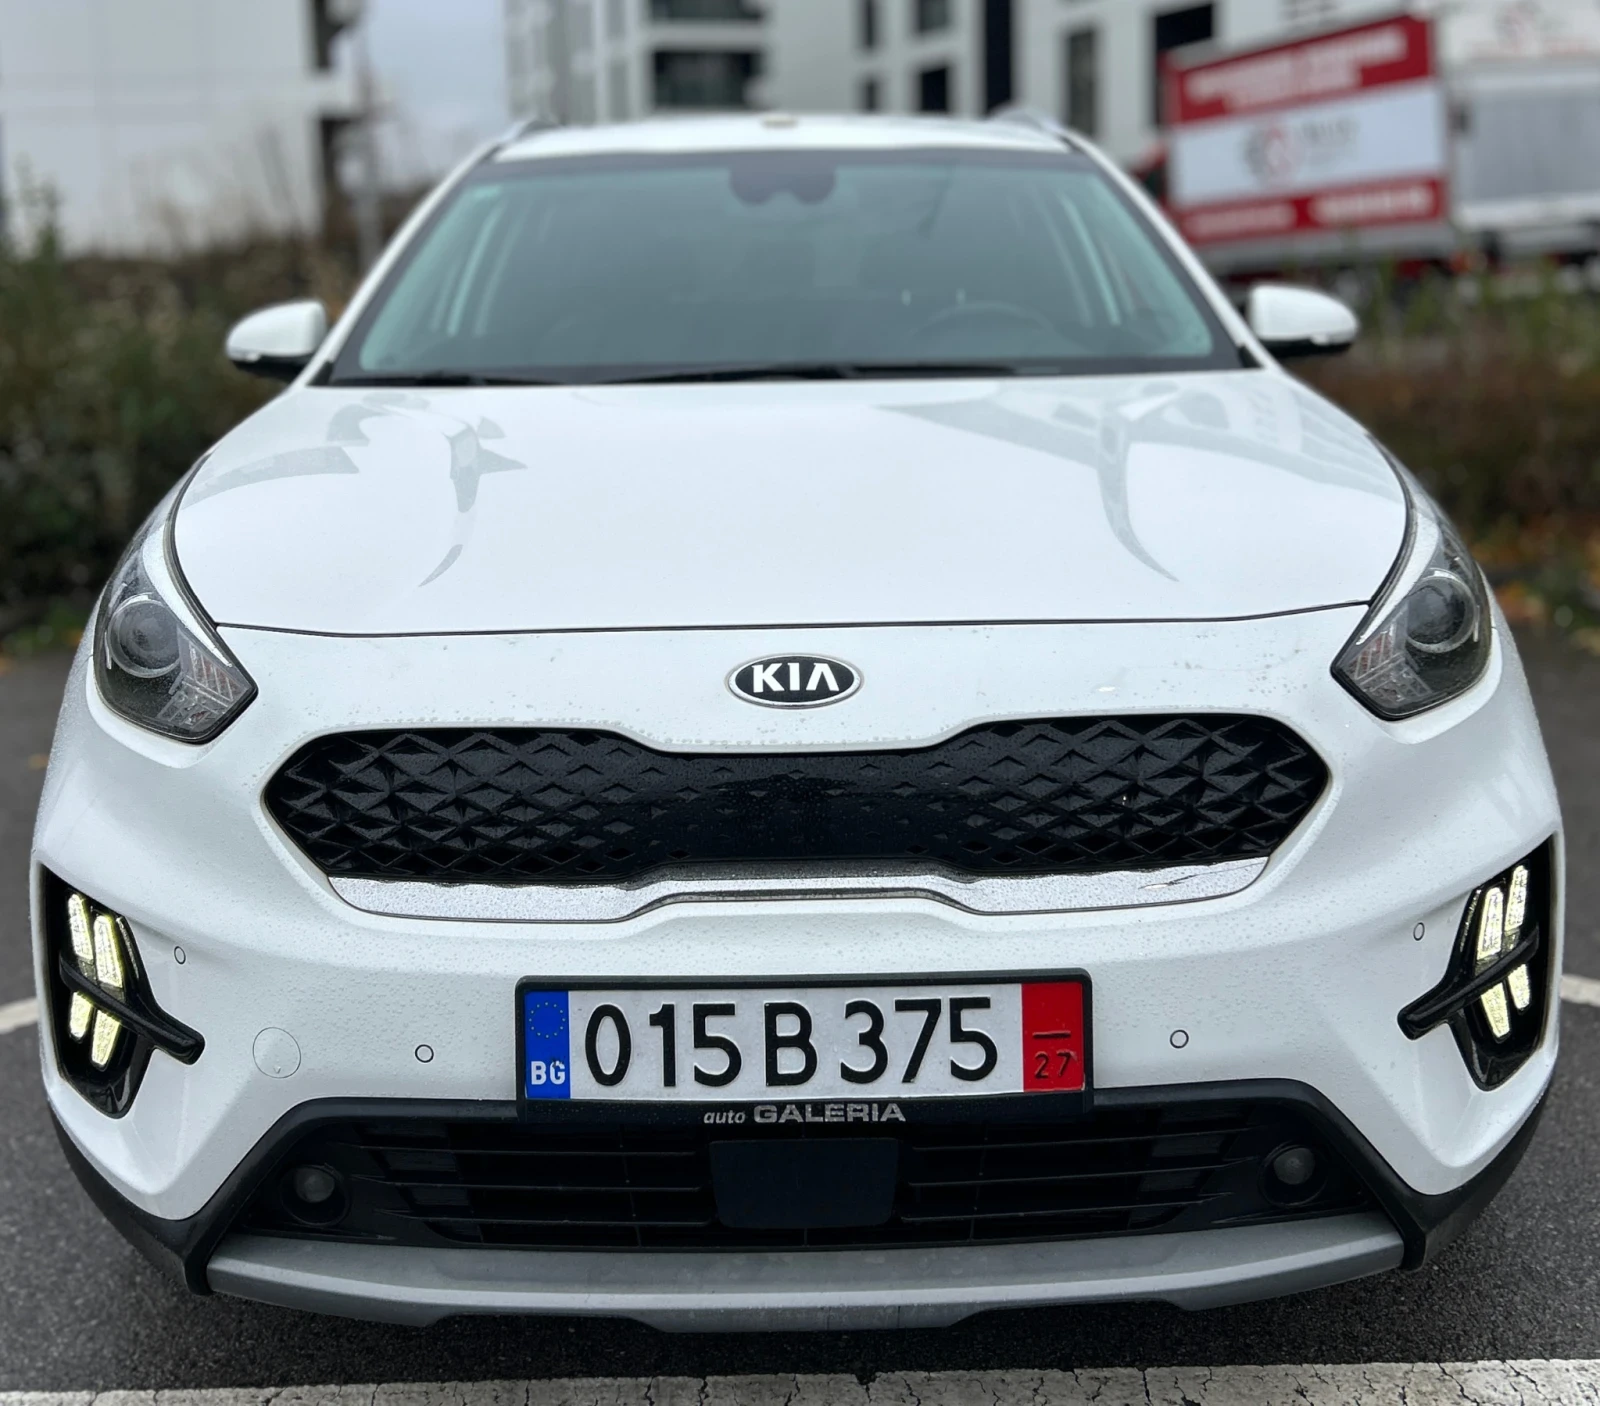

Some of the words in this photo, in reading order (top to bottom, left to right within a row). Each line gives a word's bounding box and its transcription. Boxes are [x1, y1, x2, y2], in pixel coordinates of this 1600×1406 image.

[751, 662, 840, 693] KIA
[530, 1059, 566, 1086] BG
[1034, 1050, 1075, 1079] 27
[703, 1108, 746, 1126] auto
[753, 1103, 907, 1124] GALERIA
